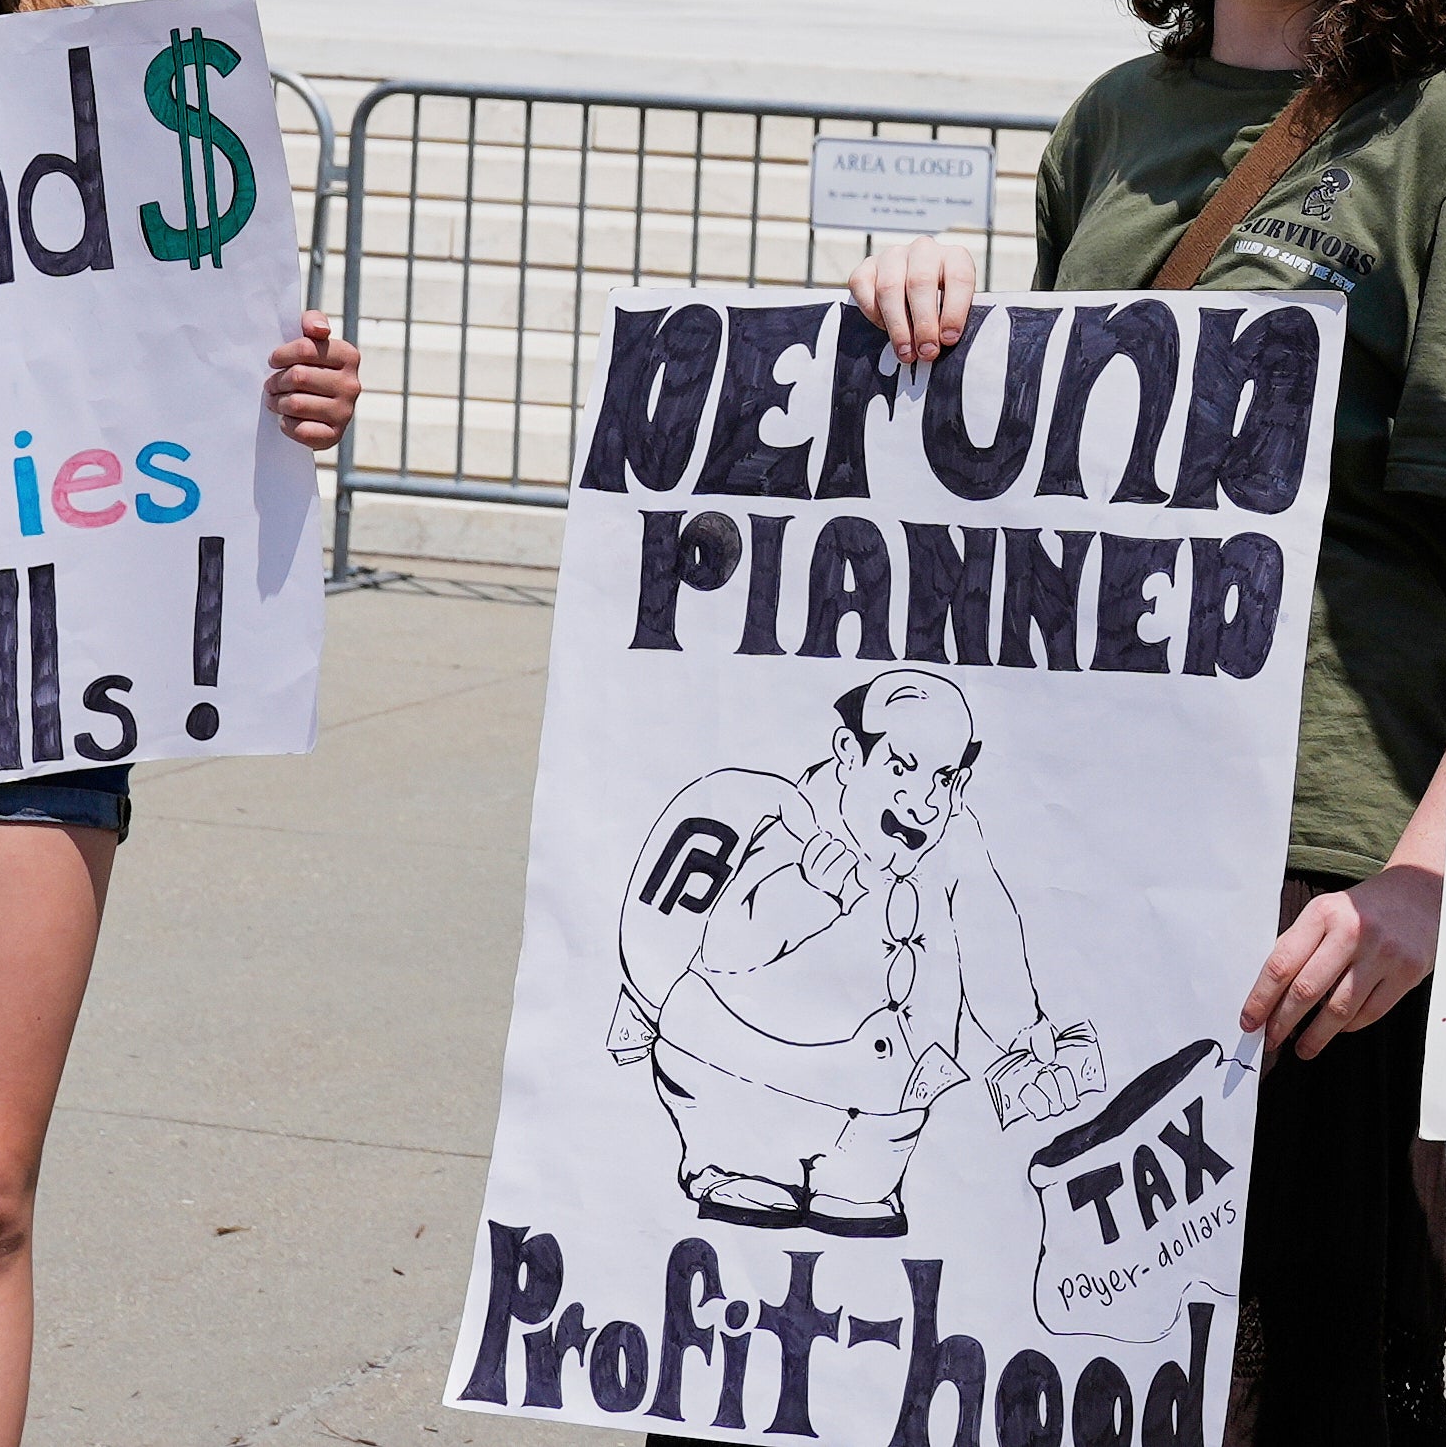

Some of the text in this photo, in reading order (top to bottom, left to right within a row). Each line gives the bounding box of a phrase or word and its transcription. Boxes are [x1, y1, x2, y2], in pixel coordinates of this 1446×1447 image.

[833, 154, 973, 178] AREA CLOSED
[579, 299, 1321, 516] DEFUND
[1066, 1096, 1235, 1245] TAX
